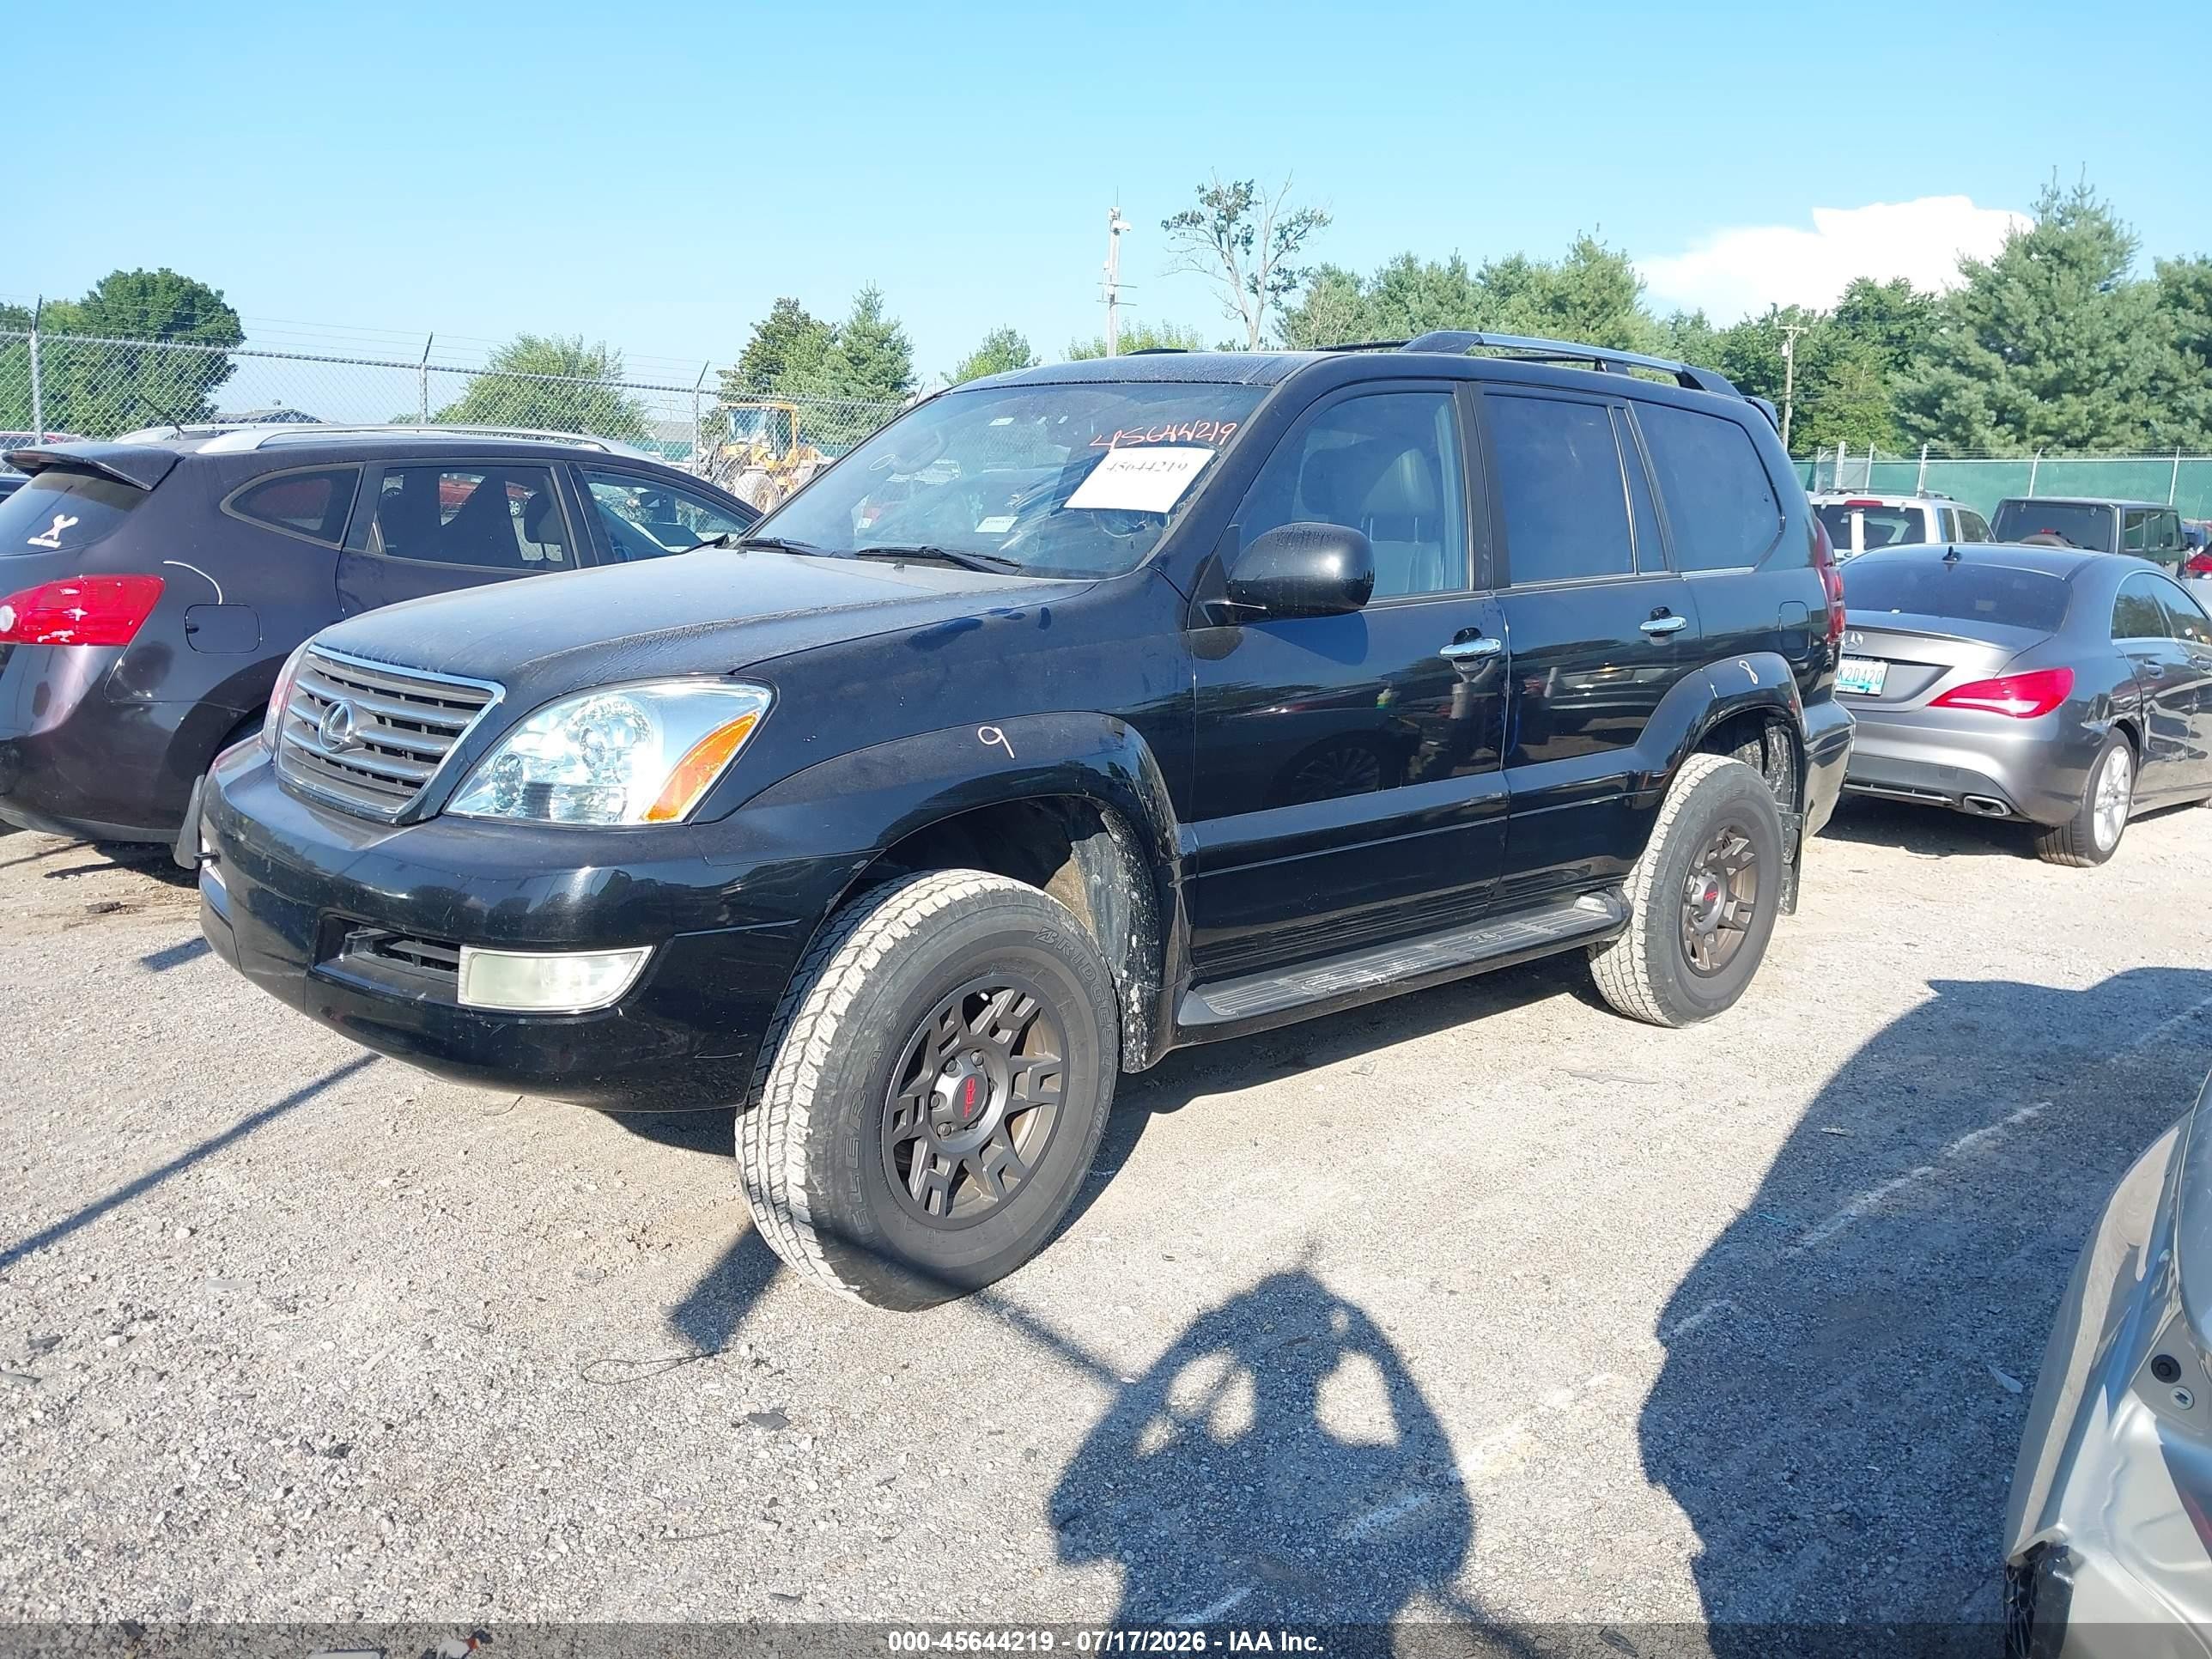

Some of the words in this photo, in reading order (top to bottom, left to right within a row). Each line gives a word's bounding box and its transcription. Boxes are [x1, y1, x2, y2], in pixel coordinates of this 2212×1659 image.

[1089, 419, 1237, 452] 45644219
[977, 726, 1015, 759] 9
[1034, 927, 1115, 1158] BRIDGESTONE
